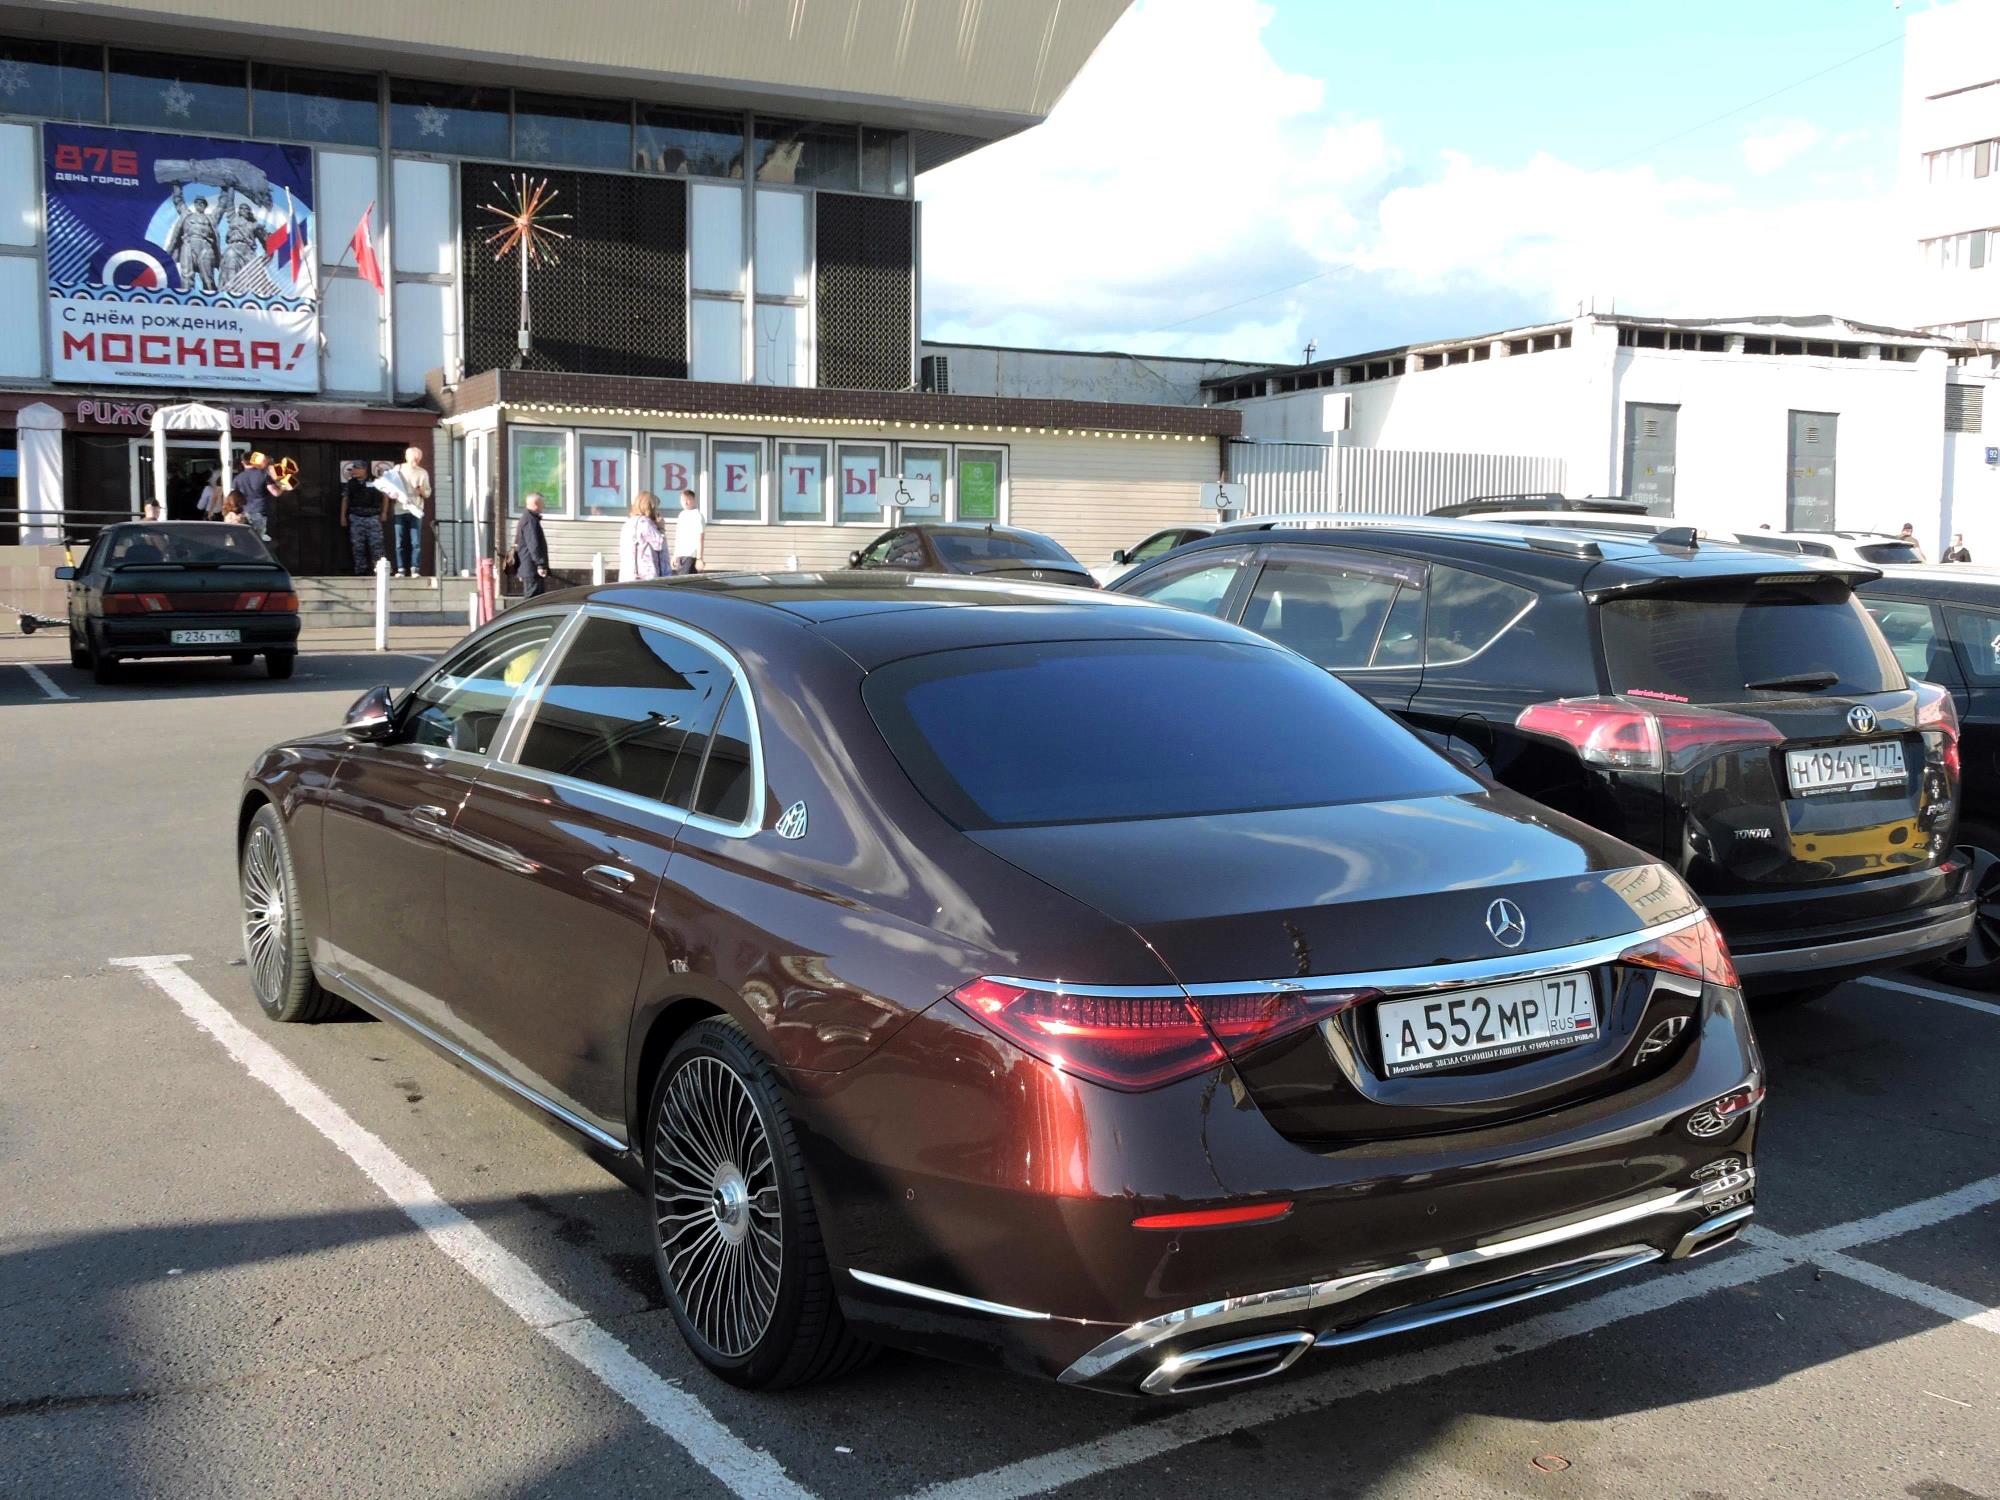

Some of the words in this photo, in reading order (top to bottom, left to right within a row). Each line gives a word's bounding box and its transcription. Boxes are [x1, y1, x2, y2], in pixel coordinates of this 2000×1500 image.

[54, 143, 139, 176] 876
[55, 172, 89, 183] ДЕНЬ
[90, 175, 140, 187] ГОРОДА
[62, 307, 77, 323] С
[82, 309, 135, 326] днём
[141, 311, 244, 334] рождения,
[62, 330, 306, 371] МОСКВА!
[1871, 743, 1897, 767] 777
[1733, 828, 1772, 840] TOYOTA
[1547, 979, 1577, 1017] 77
[1550, 1017, 1574, 1032] RUS
